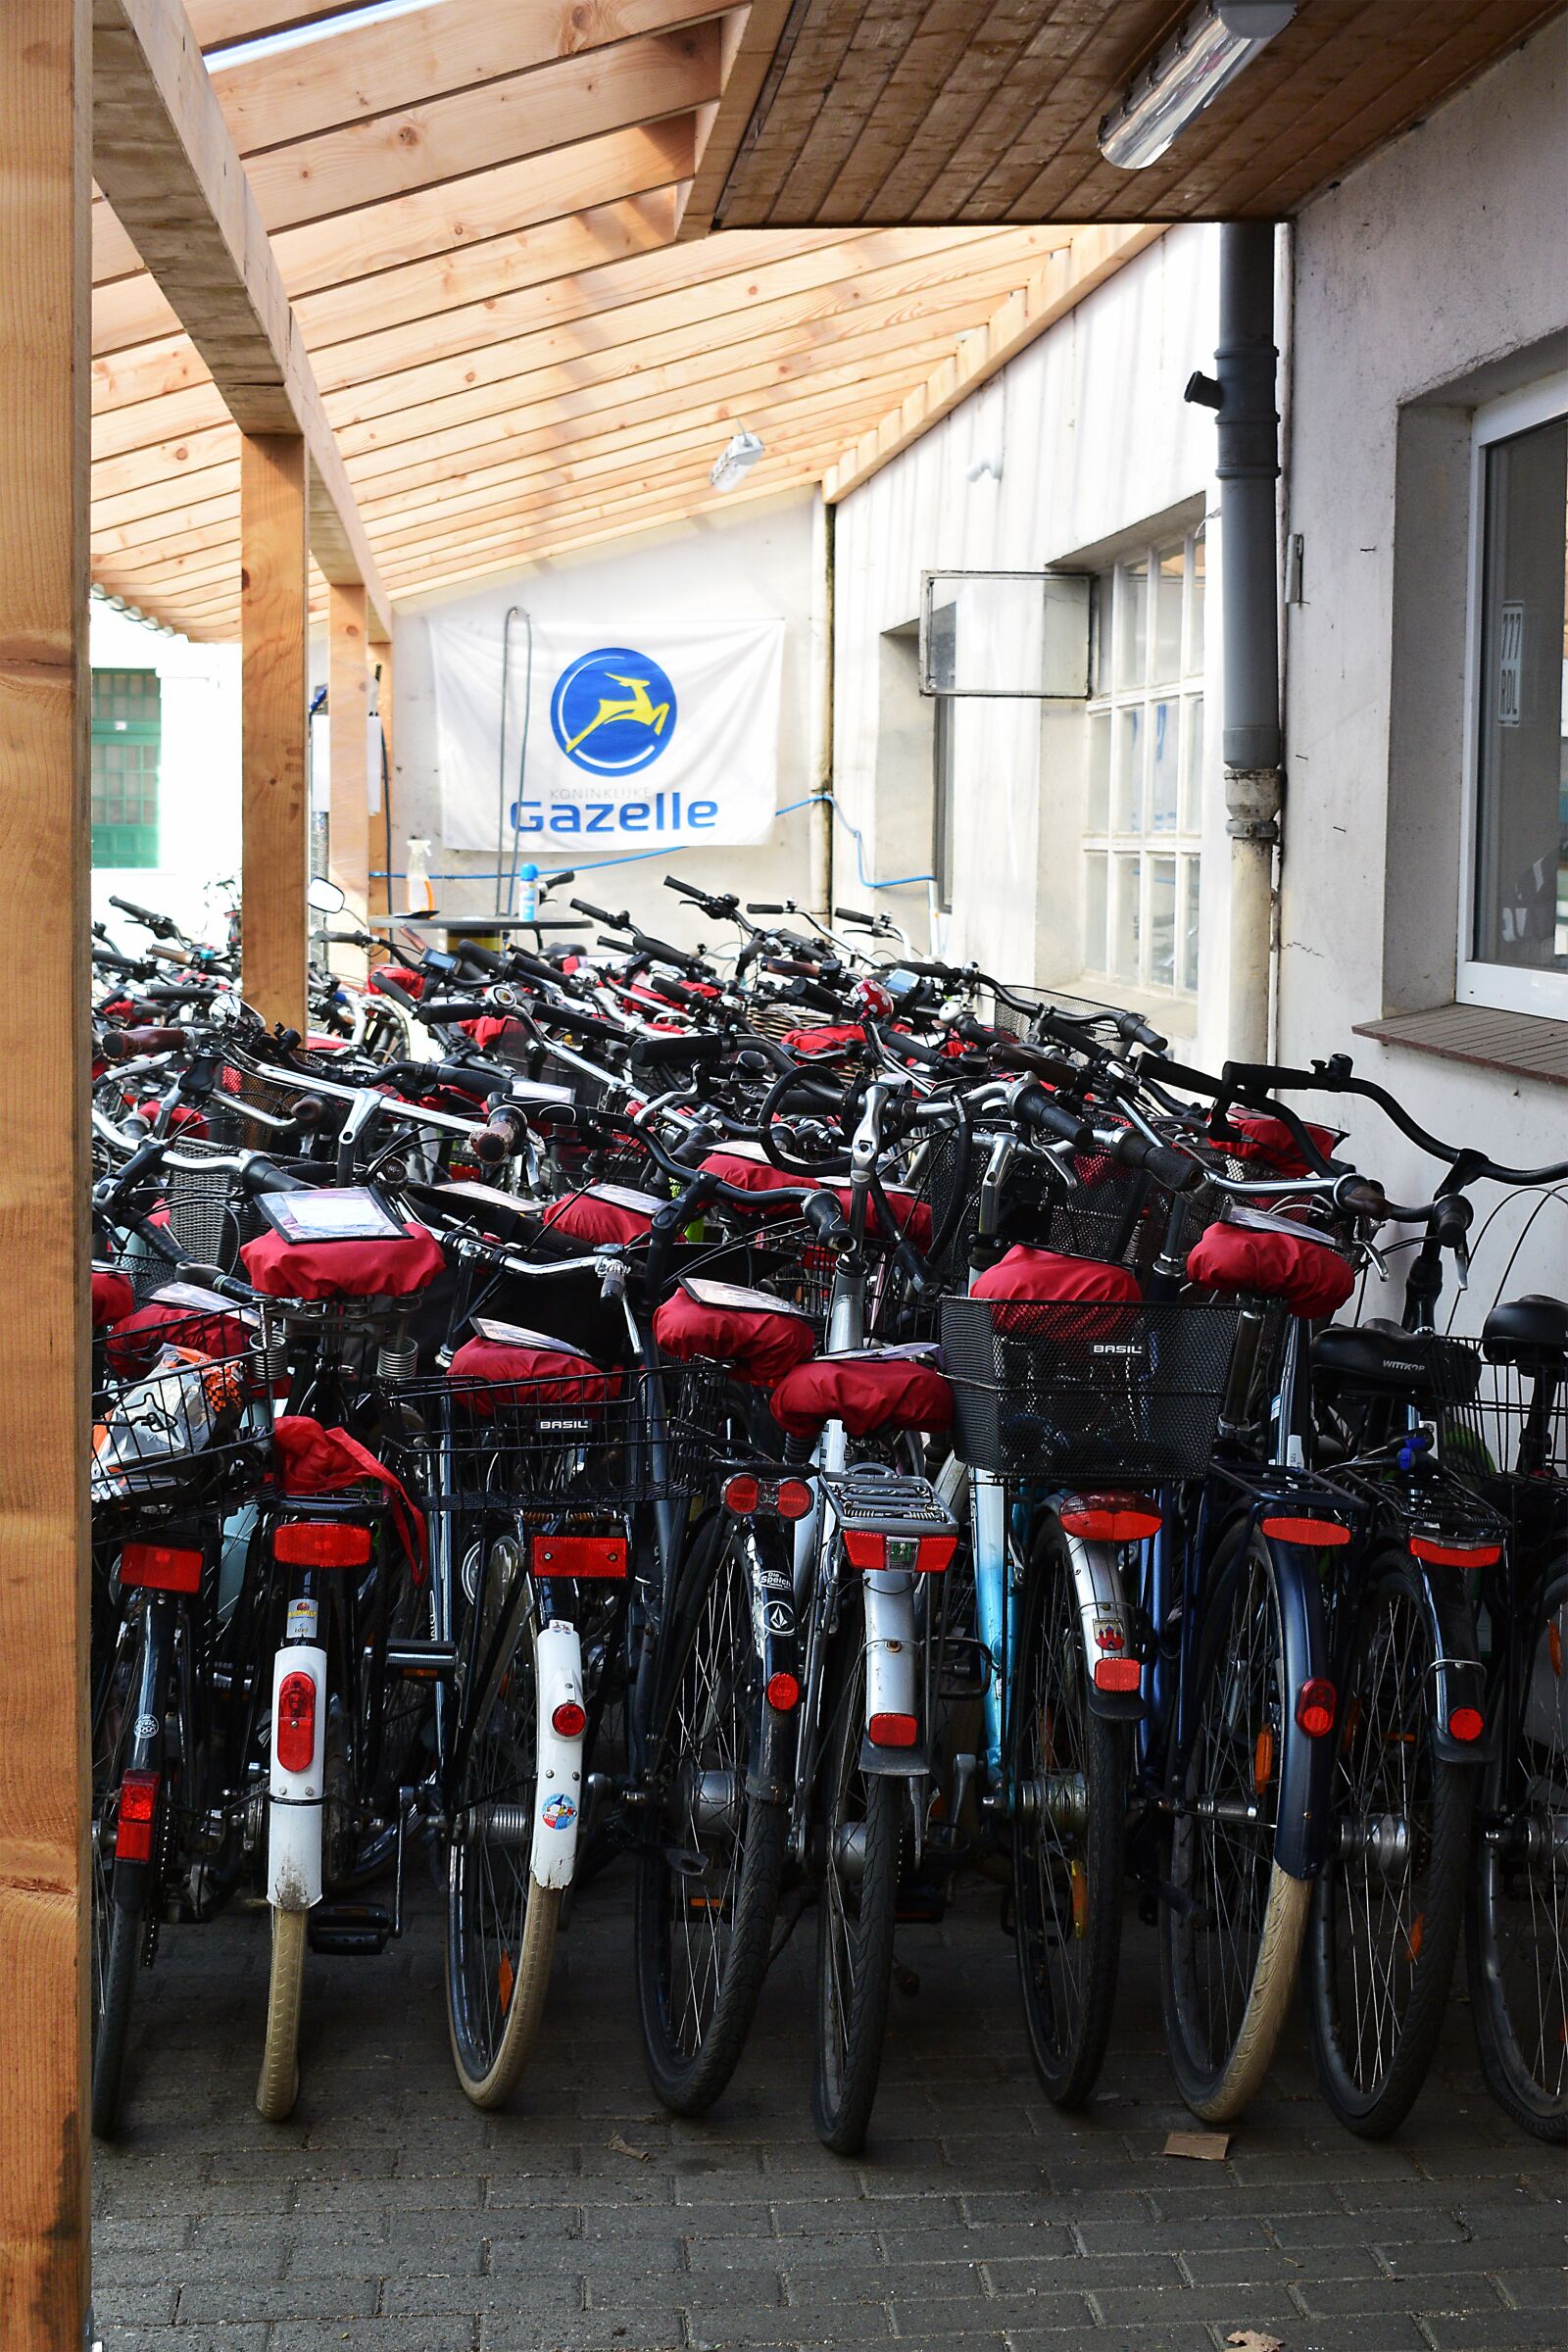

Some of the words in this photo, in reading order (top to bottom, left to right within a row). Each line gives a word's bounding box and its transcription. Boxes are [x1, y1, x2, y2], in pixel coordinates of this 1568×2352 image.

[550, 787, 652, 800] KONINKLIJKE
[510, 792, 719, 834] Gazelle
[1093, 1344, 1143, 1354] BASIL
[540, 1420, 589, 1430] BASIL
[760, 1575, 792, 1588] Speich
